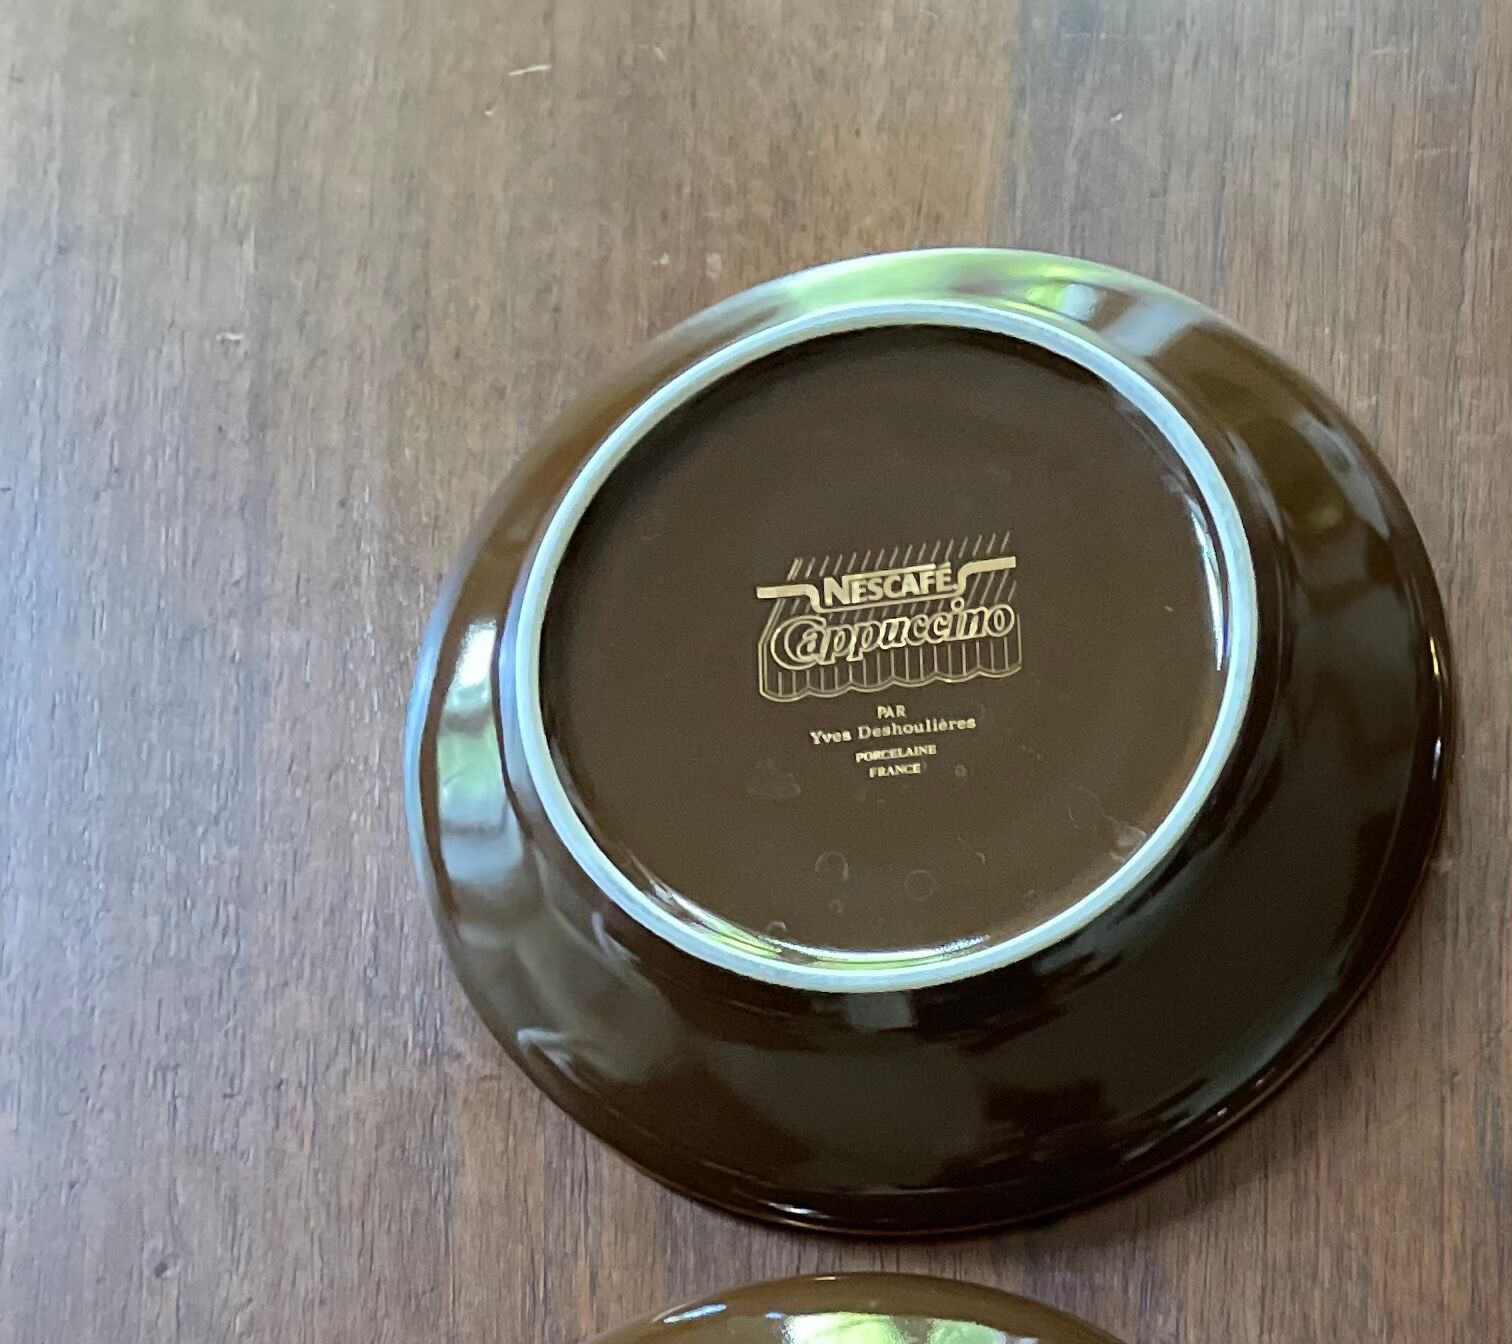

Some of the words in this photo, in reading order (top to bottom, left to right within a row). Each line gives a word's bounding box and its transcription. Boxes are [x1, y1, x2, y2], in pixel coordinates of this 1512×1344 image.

[824, 562, 952, 606] NESCAFÉ
[771, 598, 1014, 670] Cappuccino
[877, 704, 906, 719] PAR
[809, 730, 852, 746] Yves
[858, 716, 976, 740] Deshoulières
[855, 744, 937, 763] PORCELAINE
[869, 764, 921, 778] FRANCE
